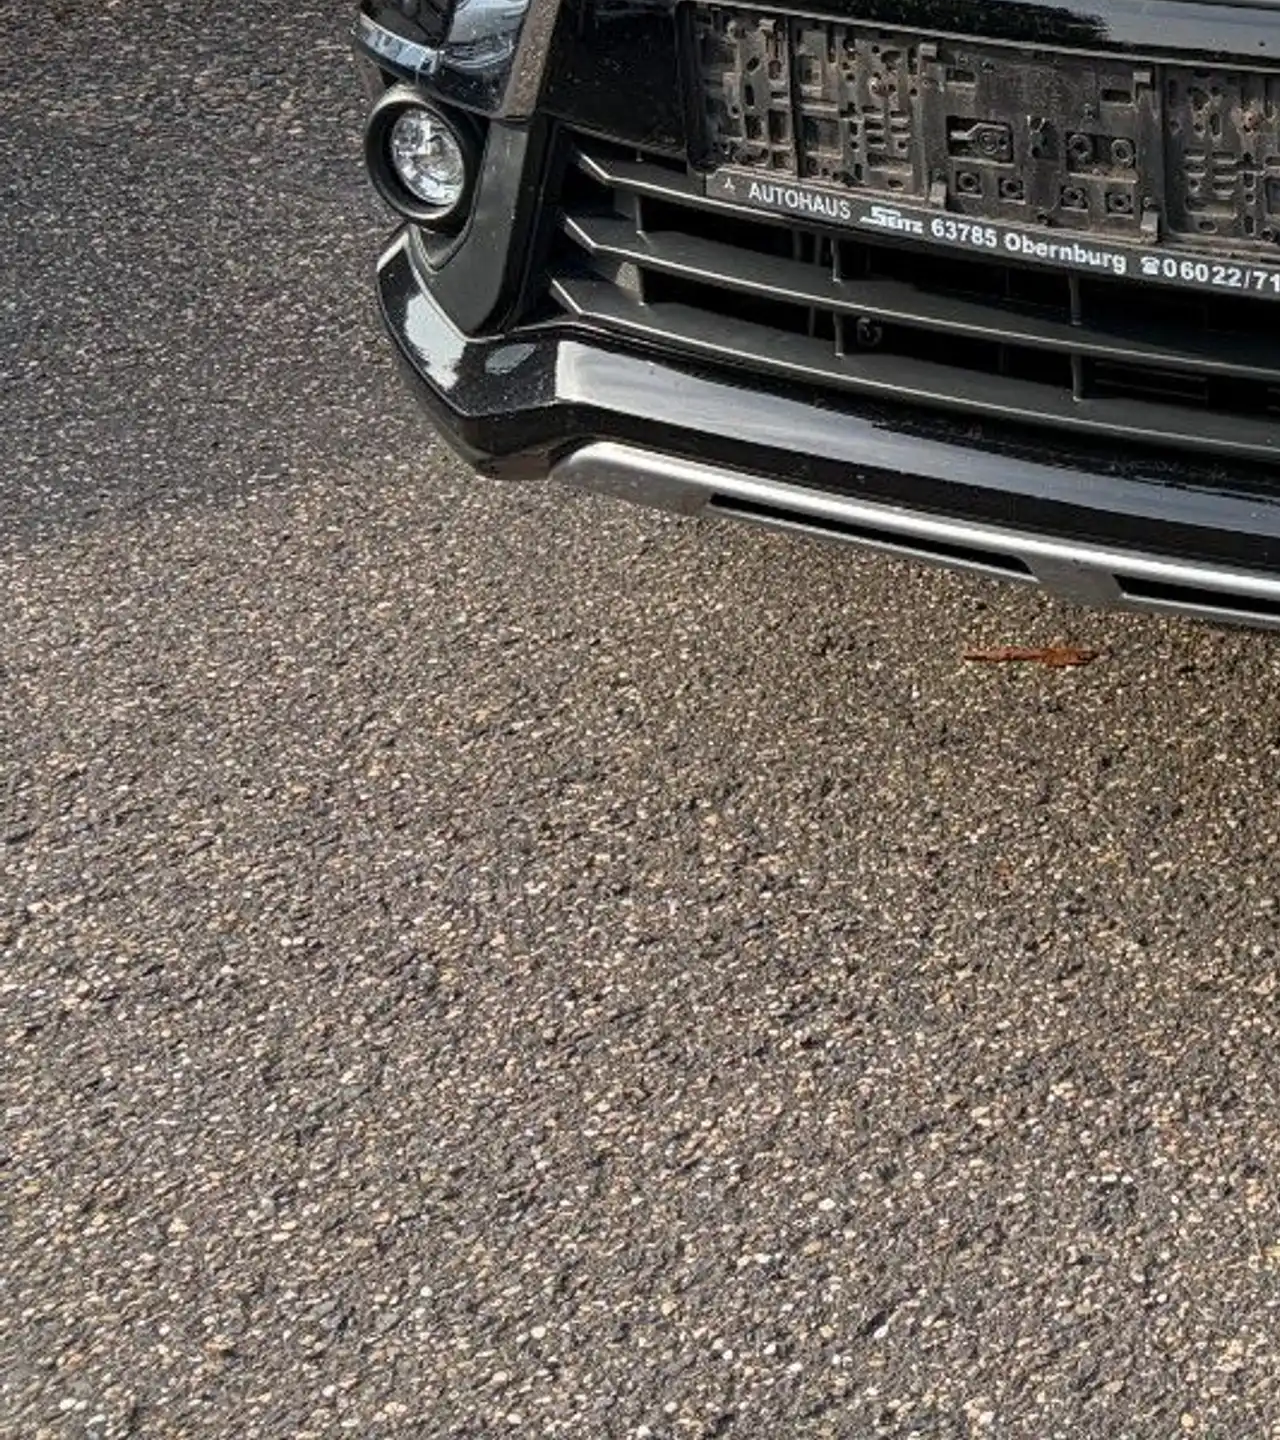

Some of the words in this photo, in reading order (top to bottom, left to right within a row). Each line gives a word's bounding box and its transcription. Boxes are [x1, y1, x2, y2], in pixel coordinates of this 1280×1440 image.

[749, 182, 851, 220] AUTOHAUS
[931, 218, 997, 249] 63785
[1003, 232, 1128, 274] Obernburg
